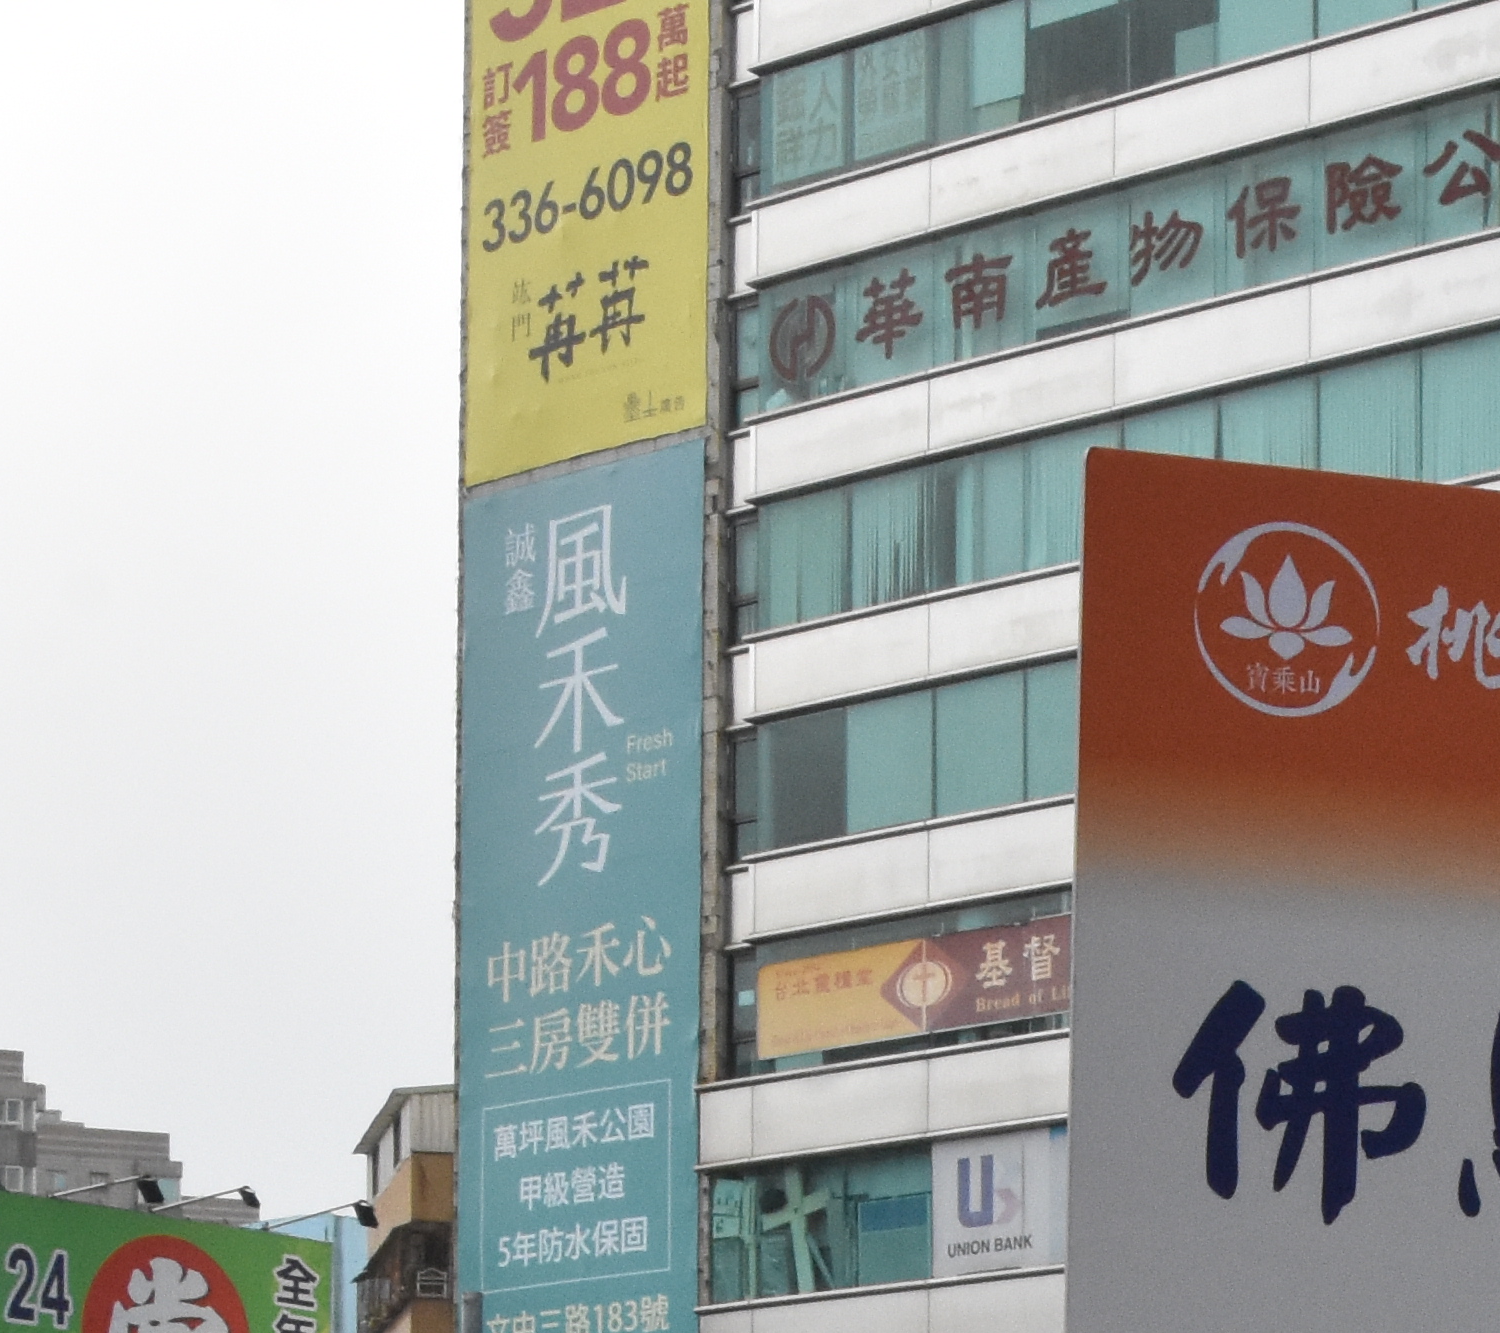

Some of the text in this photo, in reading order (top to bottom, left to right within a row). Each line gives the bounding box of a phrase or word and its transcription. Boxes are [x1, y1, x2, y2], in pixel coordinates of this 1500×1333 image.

[512, 18, 652, 143] 188
[655, 4, 690, 102] 萬起
[482, 62, 513, 158] 訂簽
[483, 142, 693, 252] 336-6098
[503, 521, 537, 617] 誠鑫
[532, 503, 627, 887] 風禾秀
[1245, 662, 1322, 698] 寶乘山
[625, 727, 674, 756] Fresh
[625, 755, 668, 784] Start
[486, 916, 673, 1003] 中路禾心
[976, 934, 1060, 989] 基督
[976, 994, 1020, 1013] Bread
[1029, 990, 1044, 1005] of
[485, 993, 671, 1081] 三房雙併
[493, 1104, 655, 1161] 萬坪風禾公園
[518, 1162, 626, 1210] 甲級營造
[497, 1217, 648, 1270] 5年防水保固
[947, 1234, 1033, 1258] UNION BANK
[7, 1248, 70, 1327] 24
